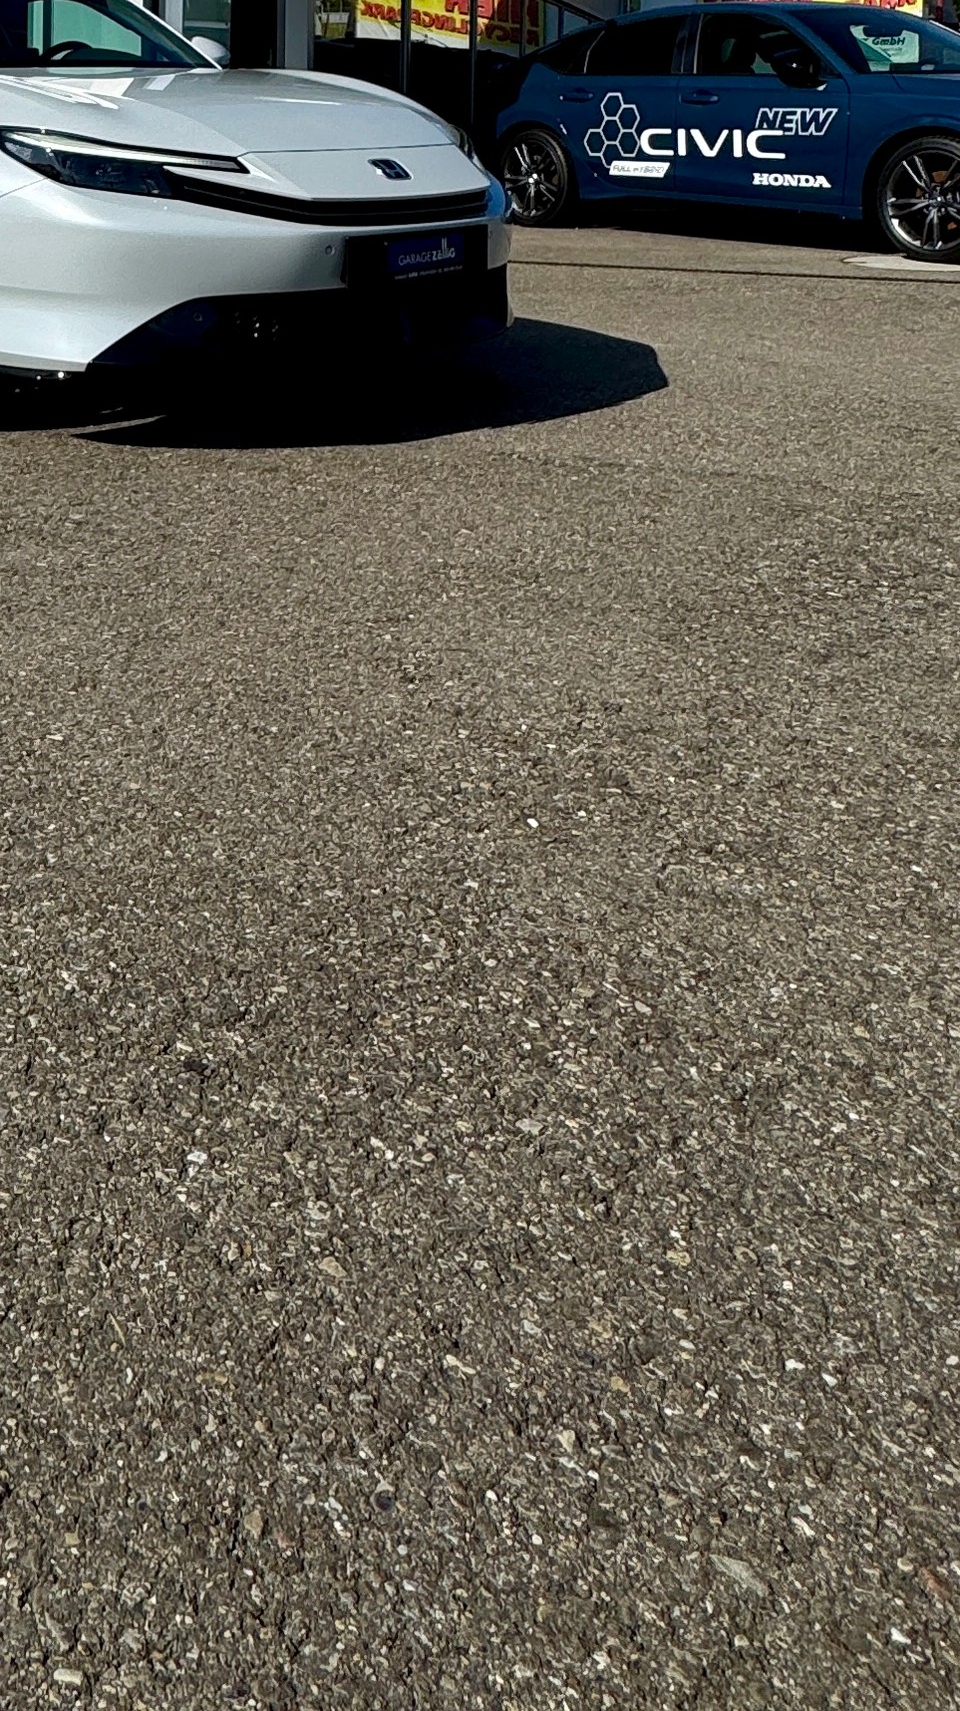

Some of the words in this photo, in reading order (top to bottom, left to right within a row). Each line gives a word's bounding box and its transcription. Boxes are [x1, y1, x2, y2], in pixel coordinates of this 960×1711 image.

[872, 36, 906, 46] GmbH
[755, 108, 838, 136] NEW
[640, 128, 786, 160] CIVIC
[752, 172, 832, 188] HONDA
[398, 251, 431, 266] GARAGE
